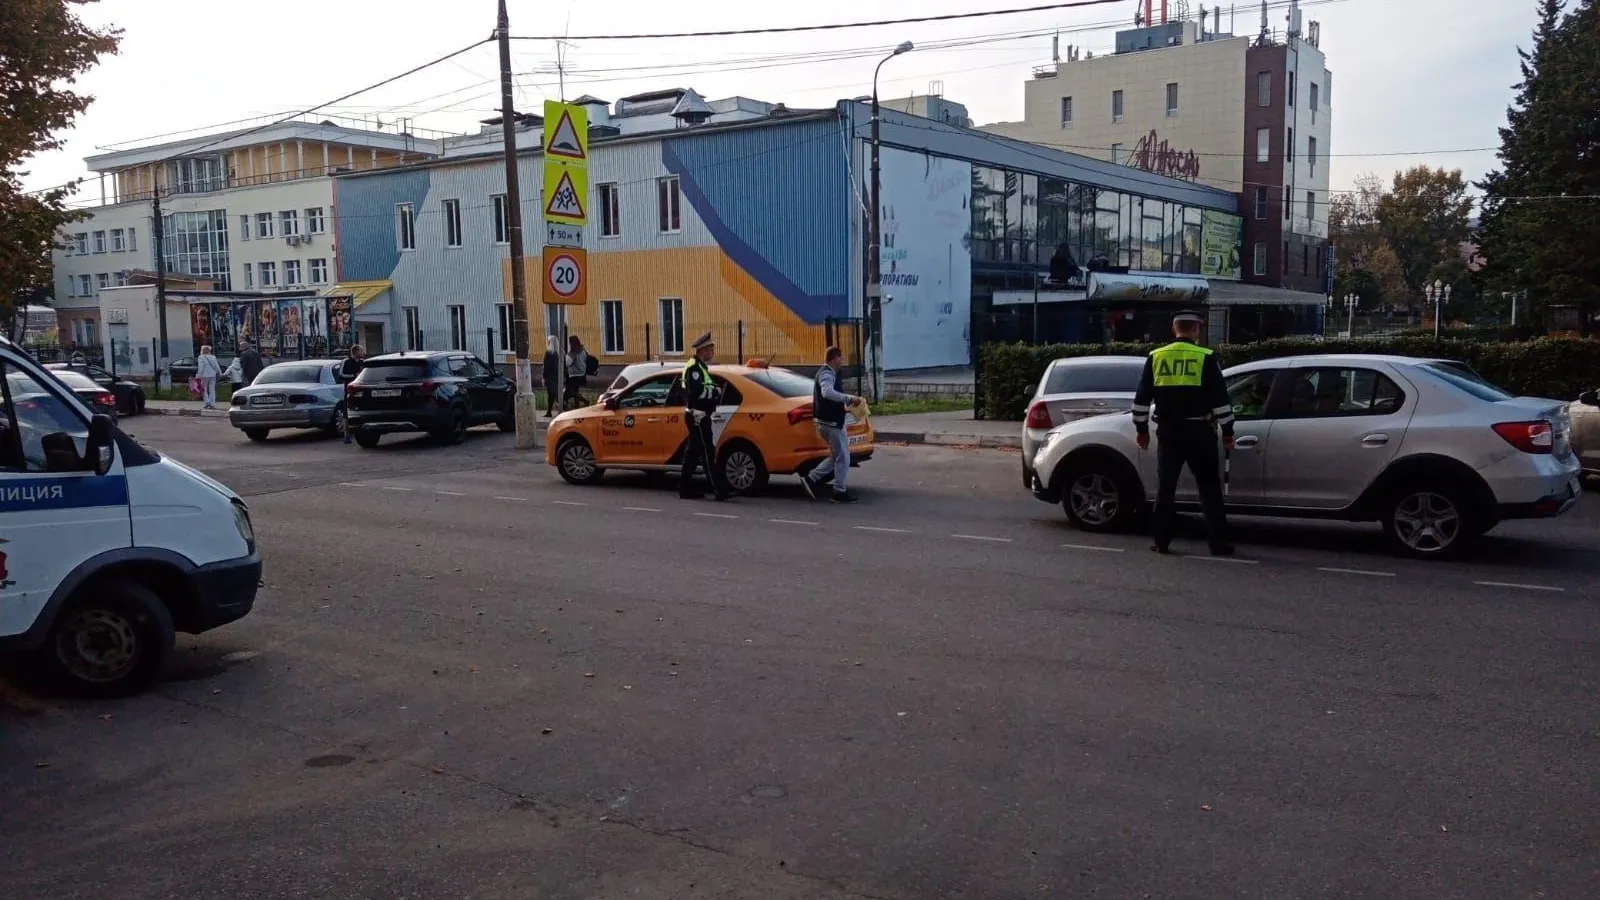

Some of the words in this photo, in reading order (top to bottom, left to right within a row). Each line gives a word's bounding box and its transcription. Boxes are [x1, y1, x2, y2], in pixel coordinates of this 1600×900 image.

[557, 231, 567, 239] 50
[556, 266, 575, 284] 20
[1158, 359, 1197, 376] ДПС
